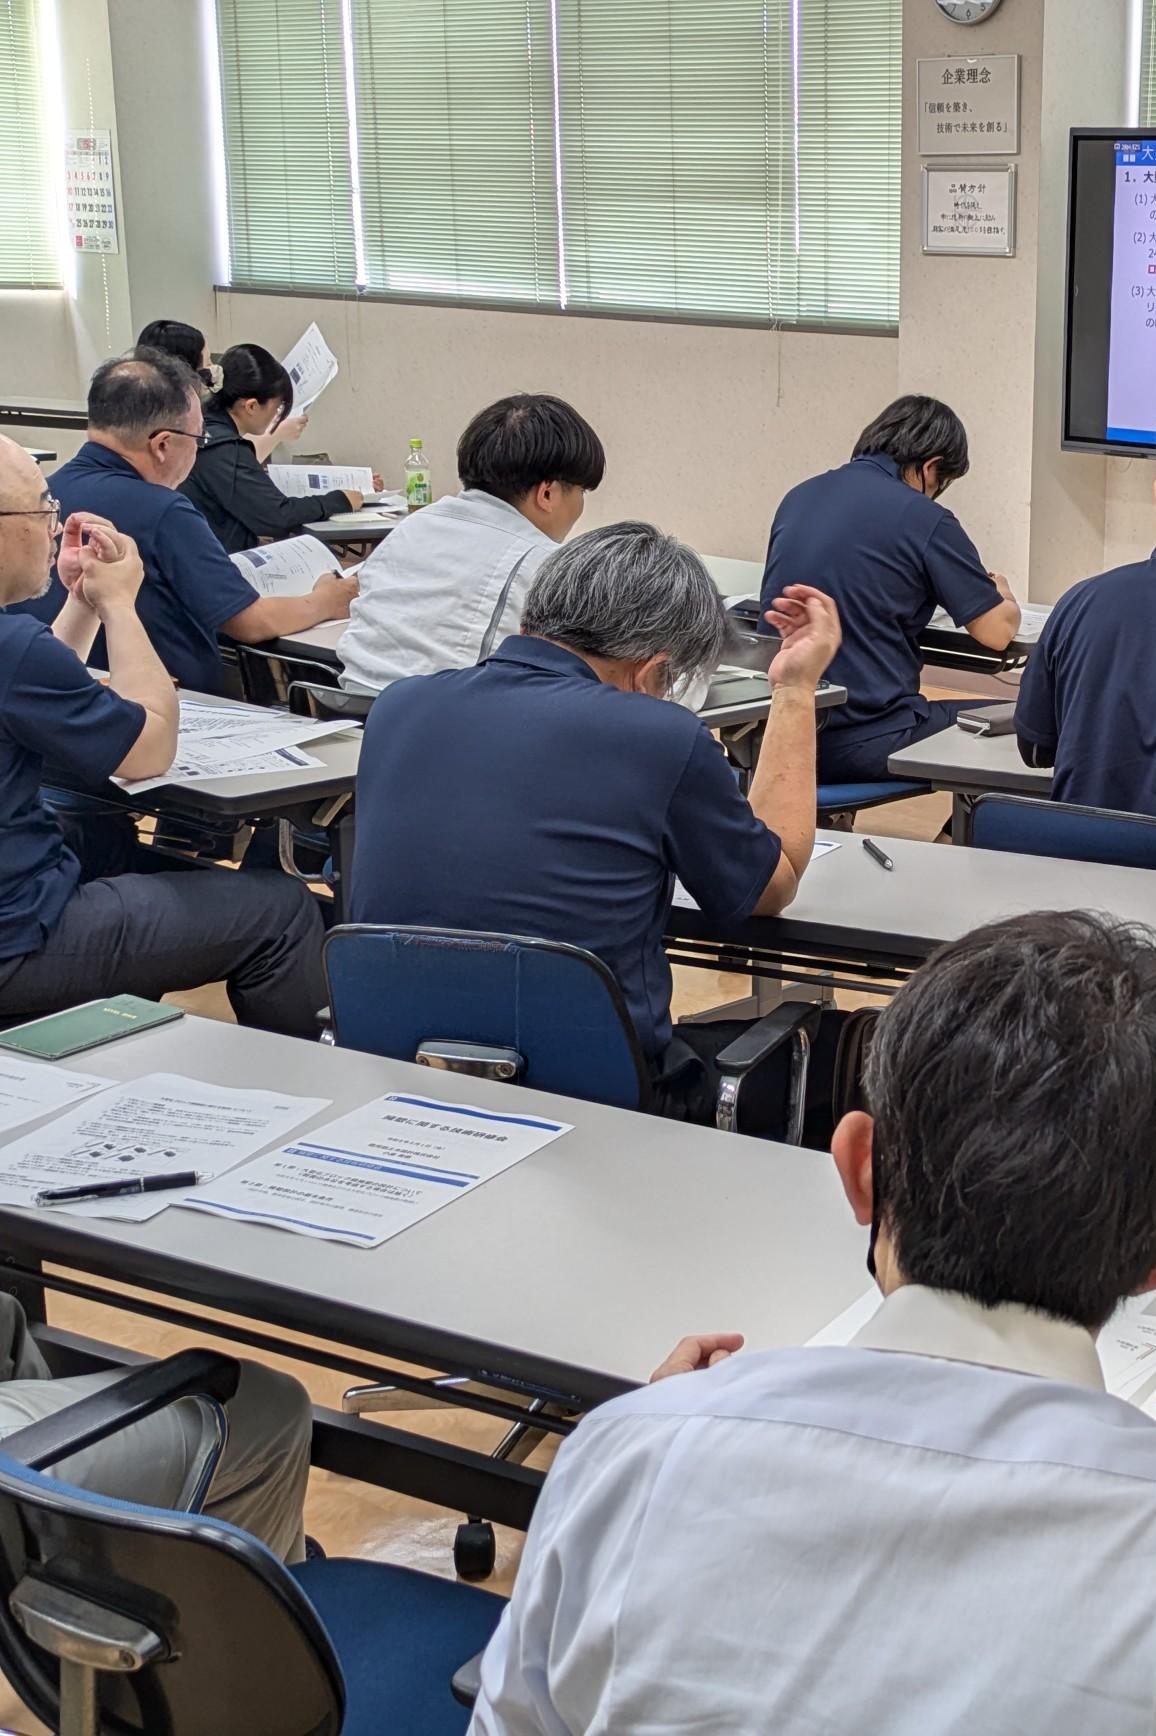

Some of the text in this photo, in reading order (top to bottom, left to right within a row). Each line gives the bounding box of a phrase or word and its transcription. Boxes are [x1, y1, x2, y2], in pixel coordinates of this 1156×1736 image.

[942, 66, 992, 85] 企業理念
[924, 102, 973, 114] 「信頼を築き、
[937, 121, 1008, 134] 技術で未来を創る」
